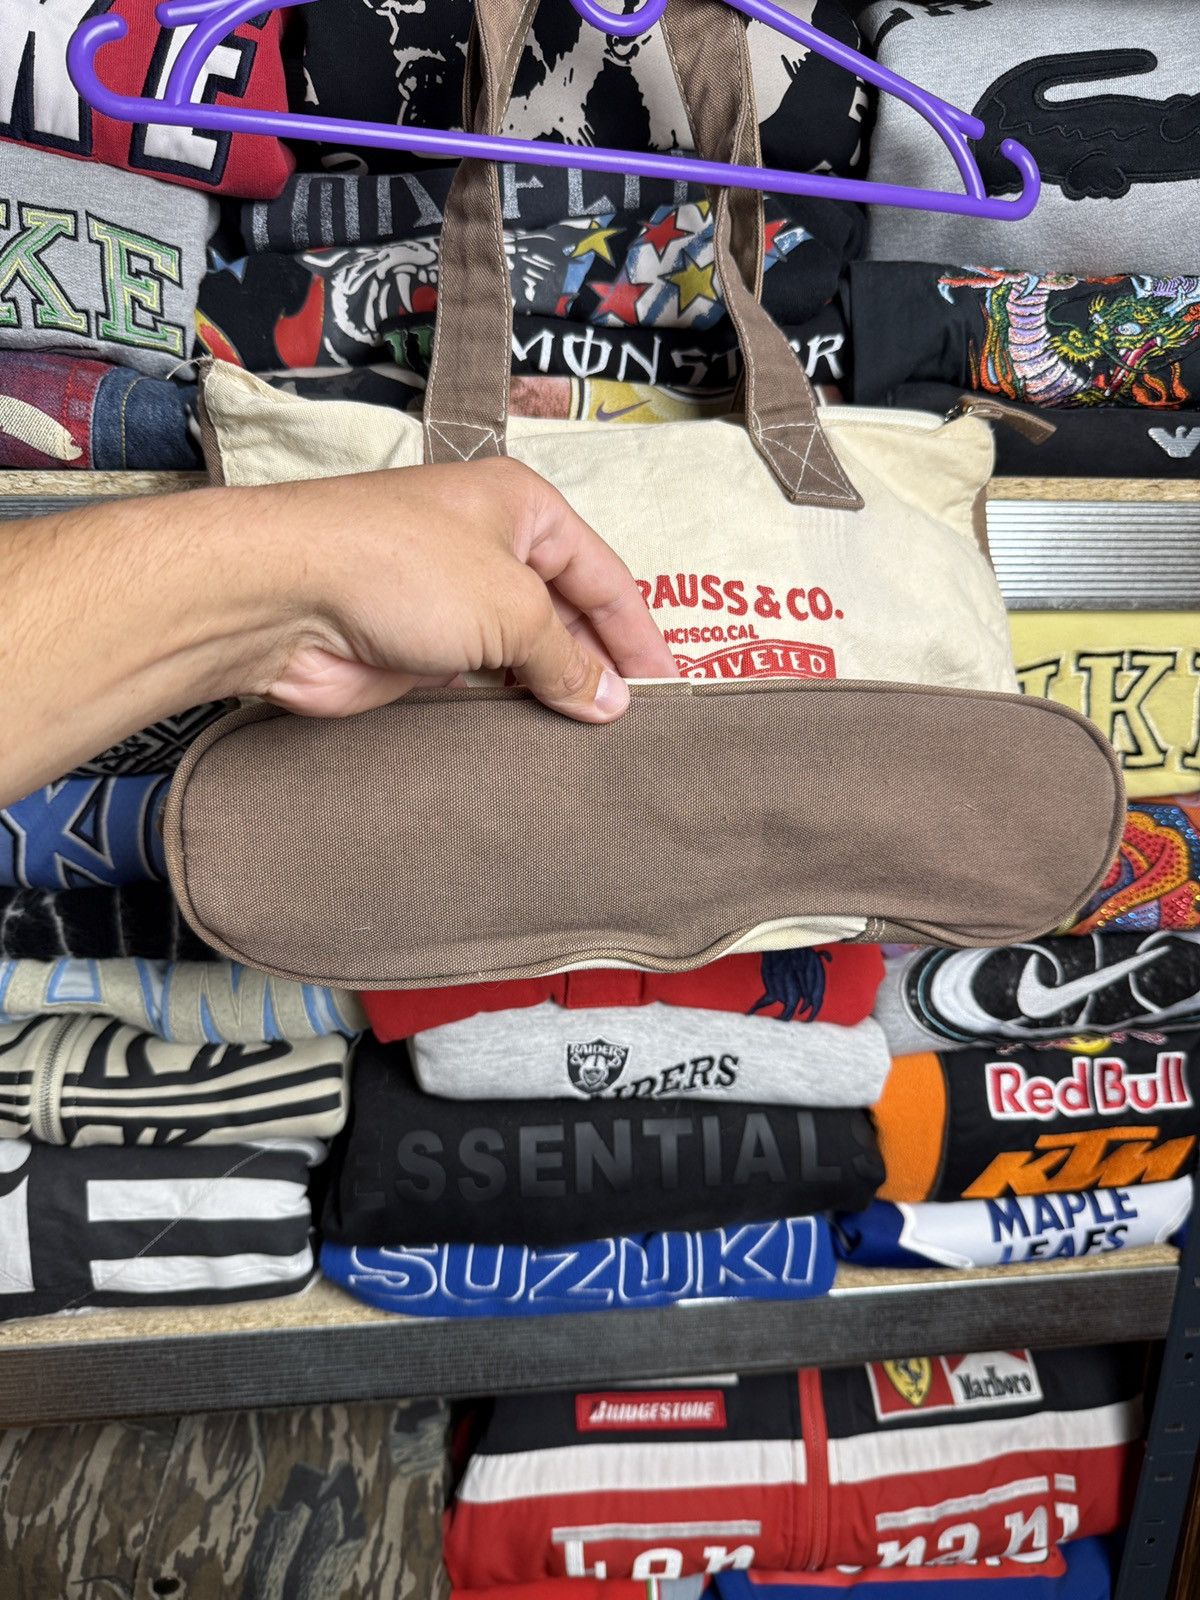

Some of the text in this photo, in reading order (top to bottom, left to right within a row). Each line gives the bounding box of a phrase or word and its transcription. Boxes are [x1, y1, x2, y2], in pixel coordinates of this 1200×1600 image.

[786, 586, 845, 621] CO.
[985, 1051, 1193, 1121] Red Bull
[960, 1125, 1197, 1199] KTM
[984, 1186, 1139, 1243] MAPLE
[348, 1215, 818, 1303] SUZUKI
